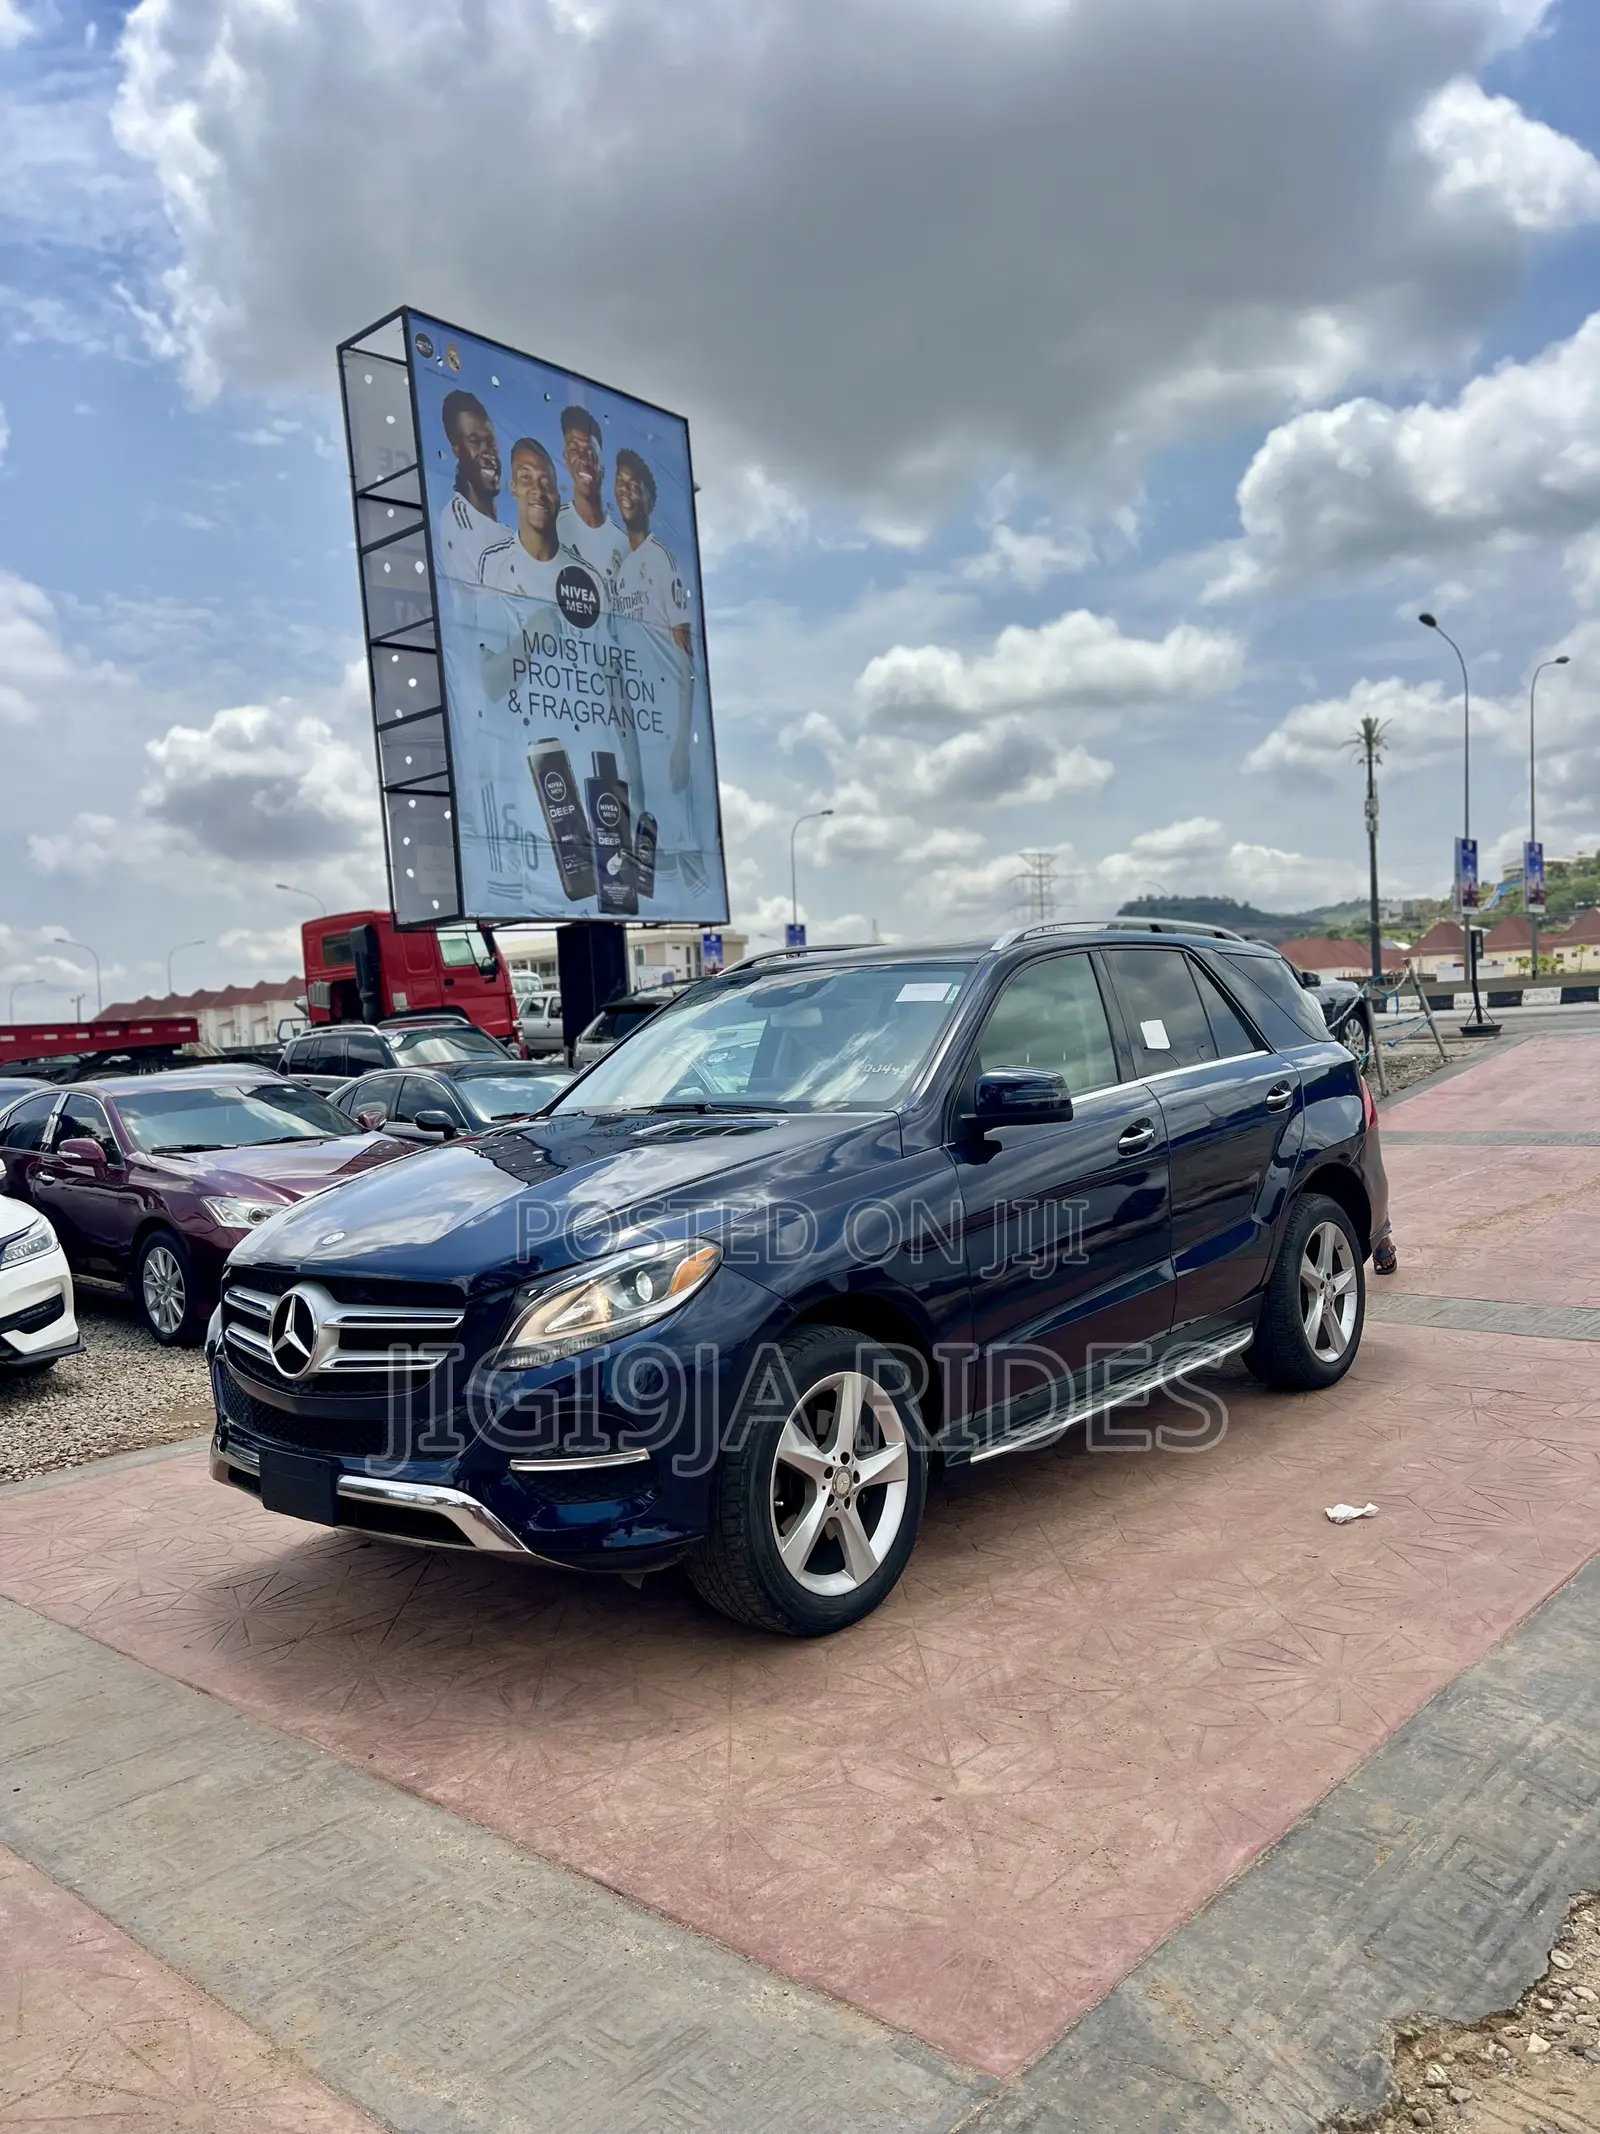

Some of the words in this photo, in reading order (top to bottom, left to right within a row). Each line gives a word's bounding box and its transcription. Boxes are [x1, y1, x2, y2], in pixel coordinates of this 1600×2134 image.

[560, 583, 597, 603] NIVEA
[566, 599, 593, 615] MEN
[522, 629, 643, 677] MOISTURE,
[512, 658, 655, 704] PROTECTION
[508, 688, 522, 714] &
[528, 692, 664, 734] FRAGRANCE
[550, 805, 575, 818] DEEP
[600, 804, 618, 812] NIVEA
[598, 836, 621, 846] DEEP
